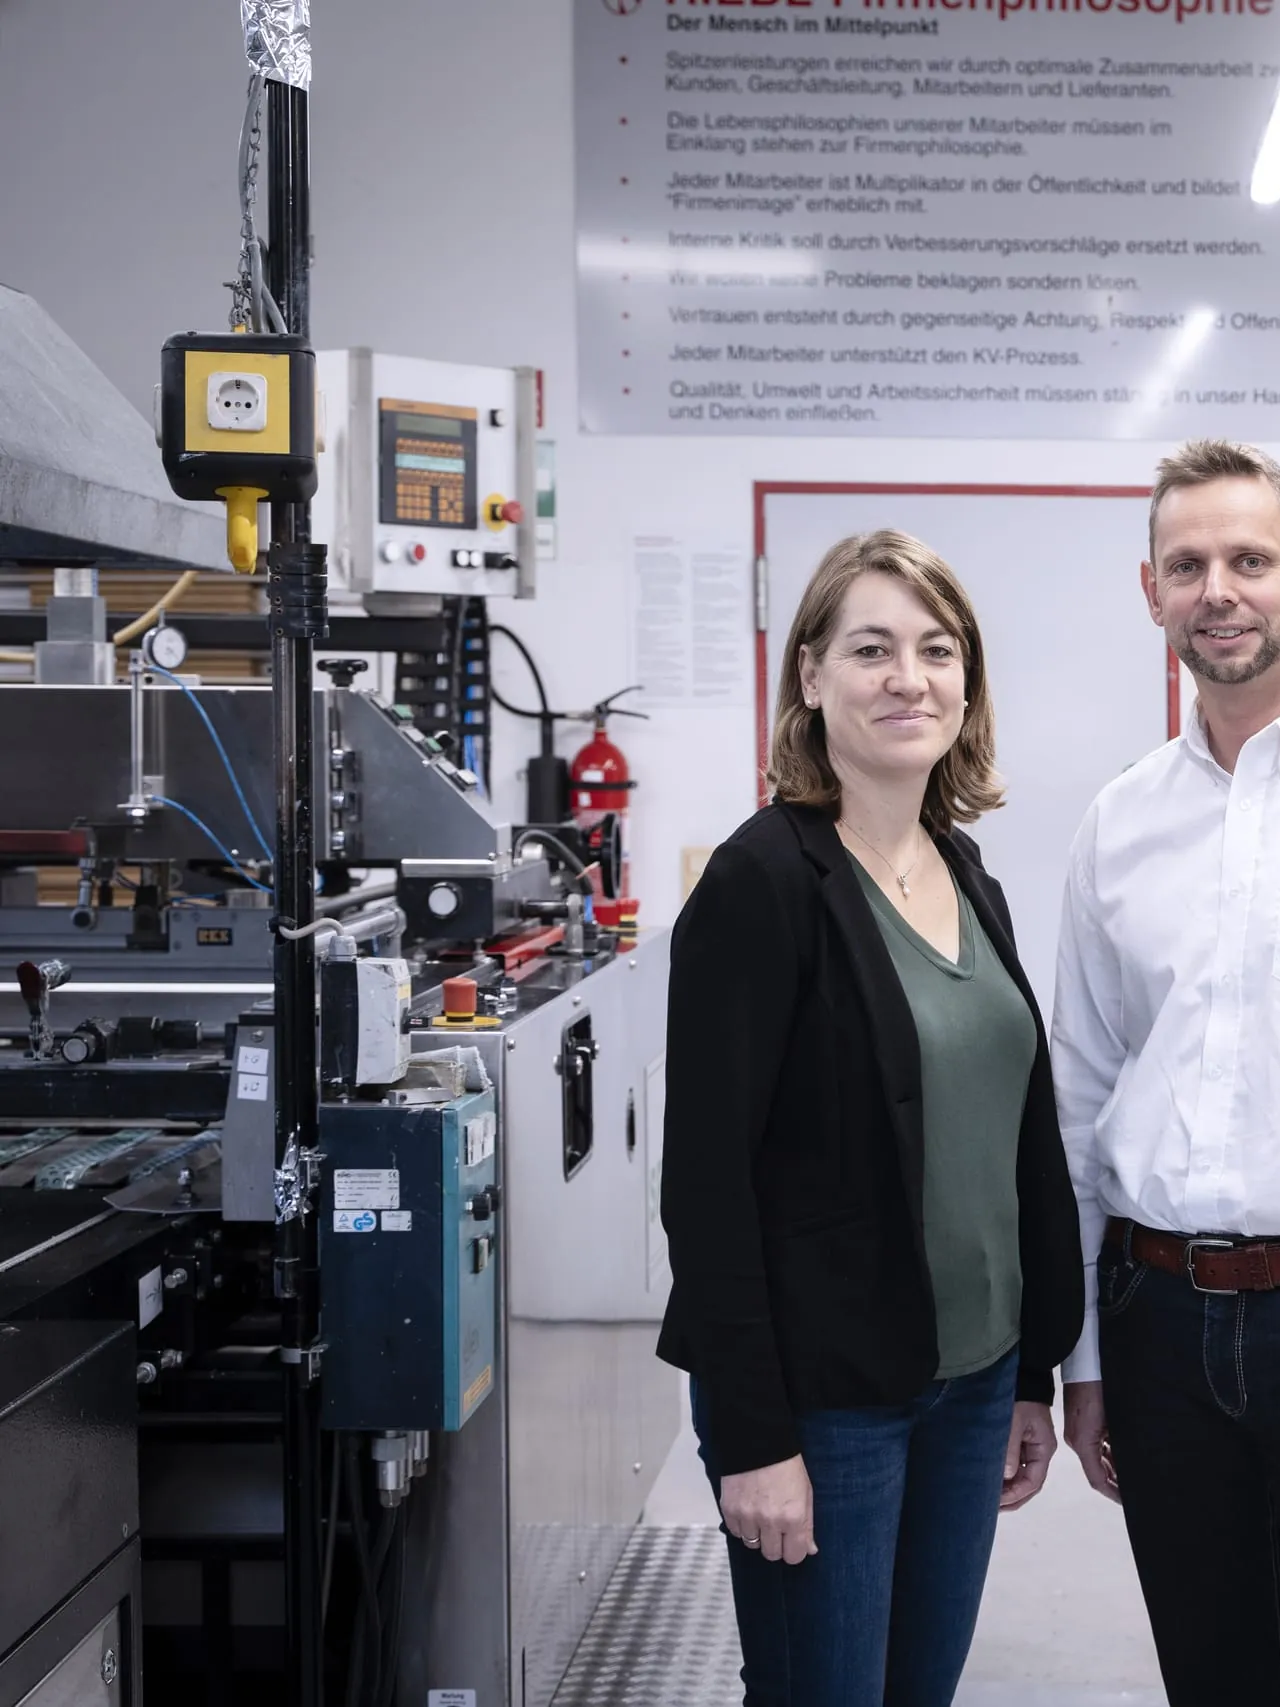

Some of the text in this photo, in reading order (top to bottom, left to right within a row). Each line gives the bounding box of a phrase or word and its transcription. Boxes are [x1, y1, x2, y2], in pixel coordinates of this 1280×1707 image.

[666, 13, 938, 39] Der Mensch im Mittelpunkt
[666, 51, 829, 75] Spitzenleistungen
[835, 53, 922, 71] erreichen
[927, 54, 954, 72] wir
[959, 55, 1011, 73] durch
[1016, 56, 1093, 79] optimale
[1099, 57, 1254, 76] Zusammenarbeit
[665, 73, 741, 94] Kunden,
[914, 77, 1023, 95] Mitarbeitern
[1029, 79, 1062, 96] und
[1068, 79, 1174, 98] Lieferanten.
[667, 110, 1171, 136] Die Lebensphilosophien unserer Mitarbeiter müssen im
[666, 132, 1026, 160] Einklang stehen zur Firmenphilosophie.
[667, 169, 720, 187] Jeder
[725, 170, 823, 189] Mitarbeiter
[829, 172, 850, 189] ist
[856, 172, 966, 196] Multiplikator
[971, 174, 987, 191] in
[993, 174, 1022, 192] der
[1029, 172, 1146, 194] Öffentlichkeit
[1152, 177, 1185, 194] und
[1191, 178, 1240, 195] bildet
[806, 194, 890, 212] erheblich
[895, 195, 926, 212] mit.
[668, 229, 1264, 258] Interne Kritik soll durch Verbesserungsvorschläge ersetzt werden.
[824, 270, 912, 287] Probleme
[917, 271, 1001, 293] beklagen
[1006, 271, 1081, 289] sondern
[668, 305, 759, 323] Vertrauen
[764, 306, 837, 324] entsteht
[842, 307, 894, 325] durch
[900, 308, 1017, 331] gegenseitige
[1110, 310, 1185, 333] Respekt
[668, 343, 1082, 365] Jeder Mitarbeiter unterstützt den KV-Prozess.
[752, 380, 821, 398] Umwelt
[827, 381, 861, 398] und
[867, 381, 1018, 400] Arbeitssicherheit
[1025, 383, 1096, 401] müssen
[1174, 385, 1190, 403] in
[1197, 390, 1246, 403] unser
[669, 402, 880, 420] und Denken einfließen.
